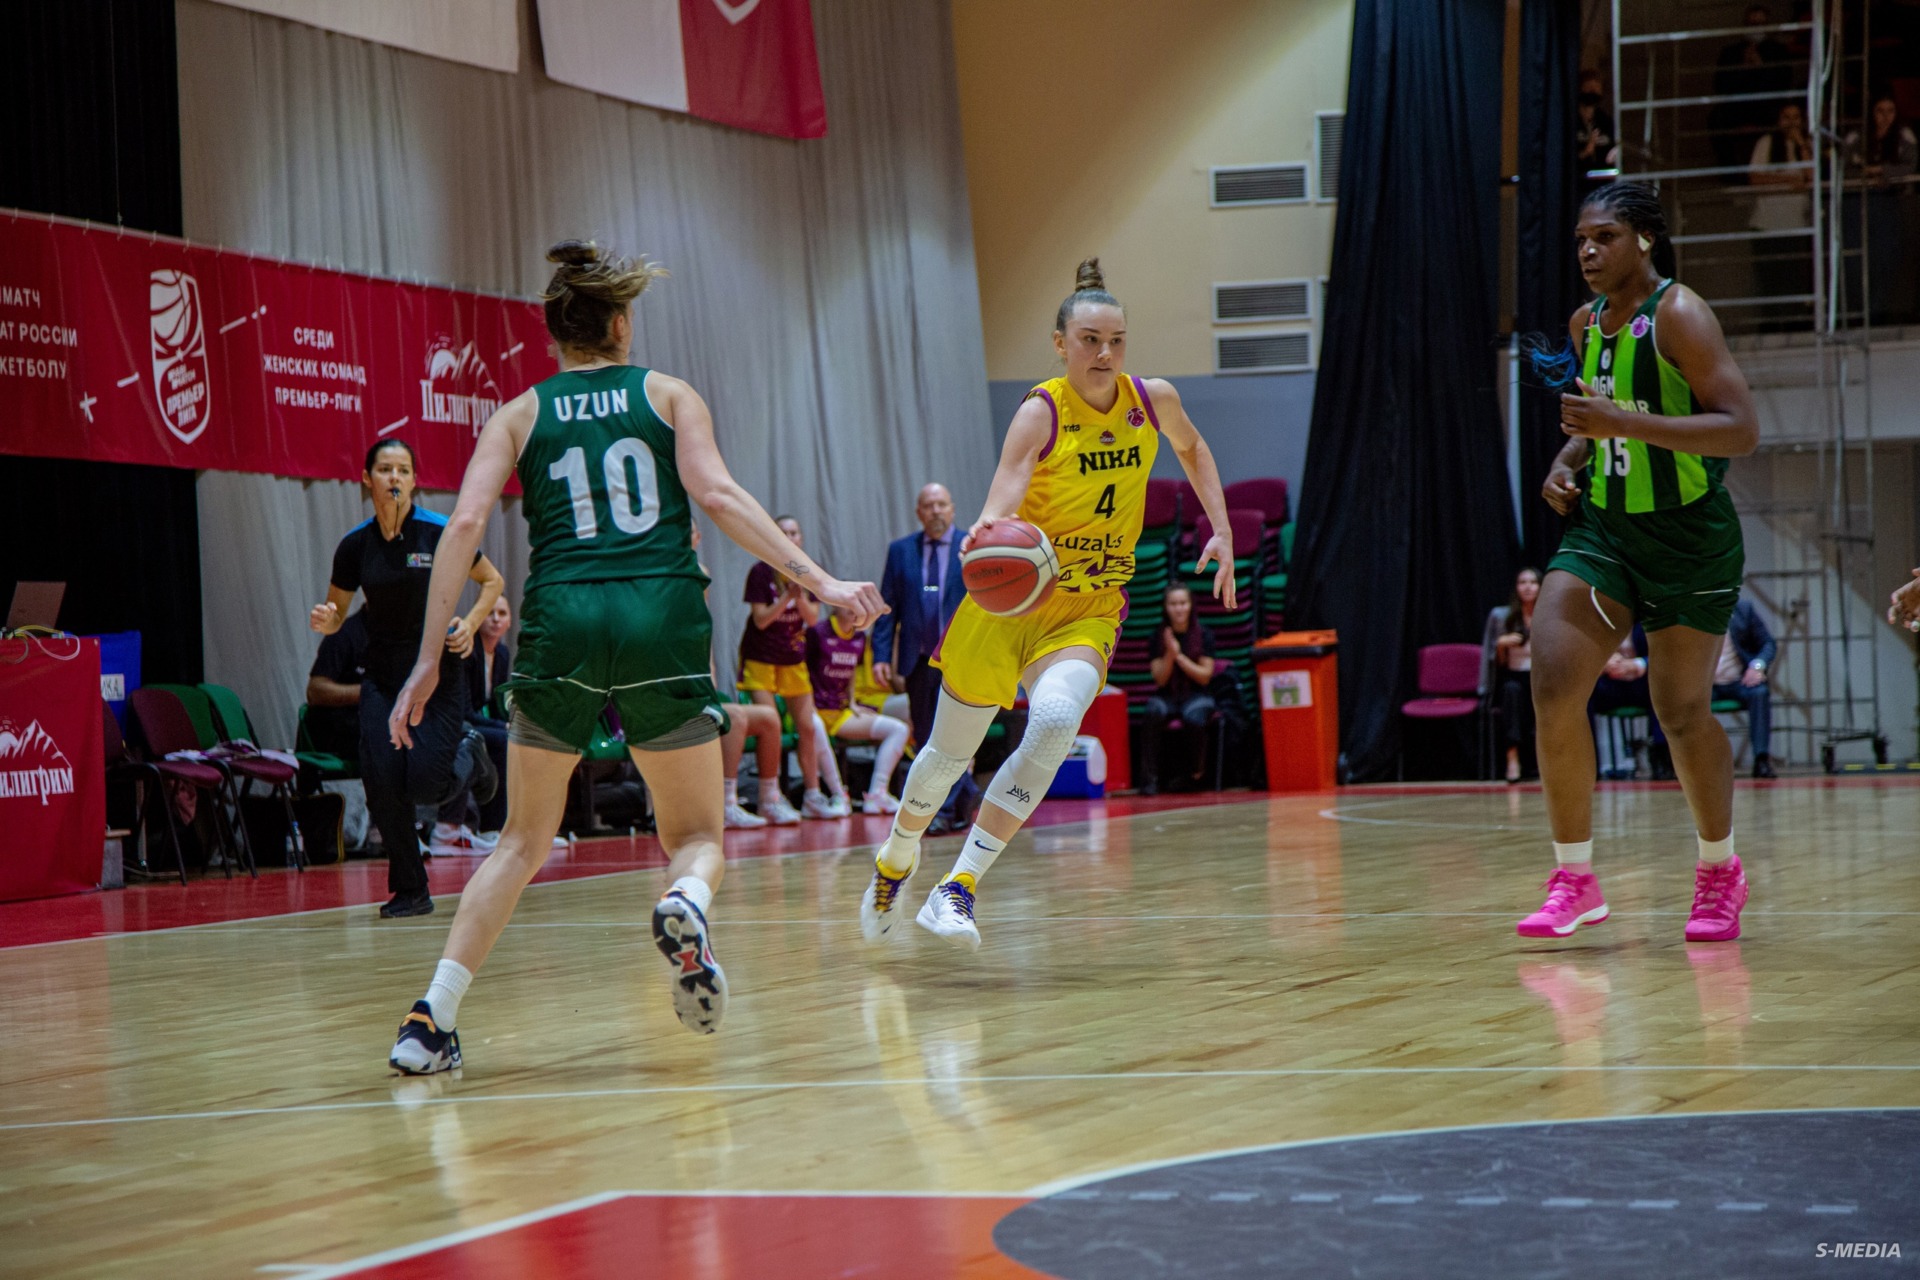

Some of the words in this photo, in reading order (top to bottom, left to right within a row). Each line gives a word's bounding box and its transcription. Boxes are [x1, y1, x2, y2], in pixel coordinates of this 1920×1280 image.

[19, 322, 78, 347] РОССИИ
[293, 326, 335, 350] СРЕДИ
[263, 353, 319, 378] ЖЕНСКИХ
[321, 361, 367, 387] КОМАНД
[274, 386, 362, 413] ПРЕМЬЕР-ЛИГИ
[554, 388, 629, 422] UZUN
[1077, 445, 1142, 476] NIKA
[1600, 436, 1631, 477] 15
[549, 437, 660, 540] 10
[1094, 483, 1116, 520] 4
